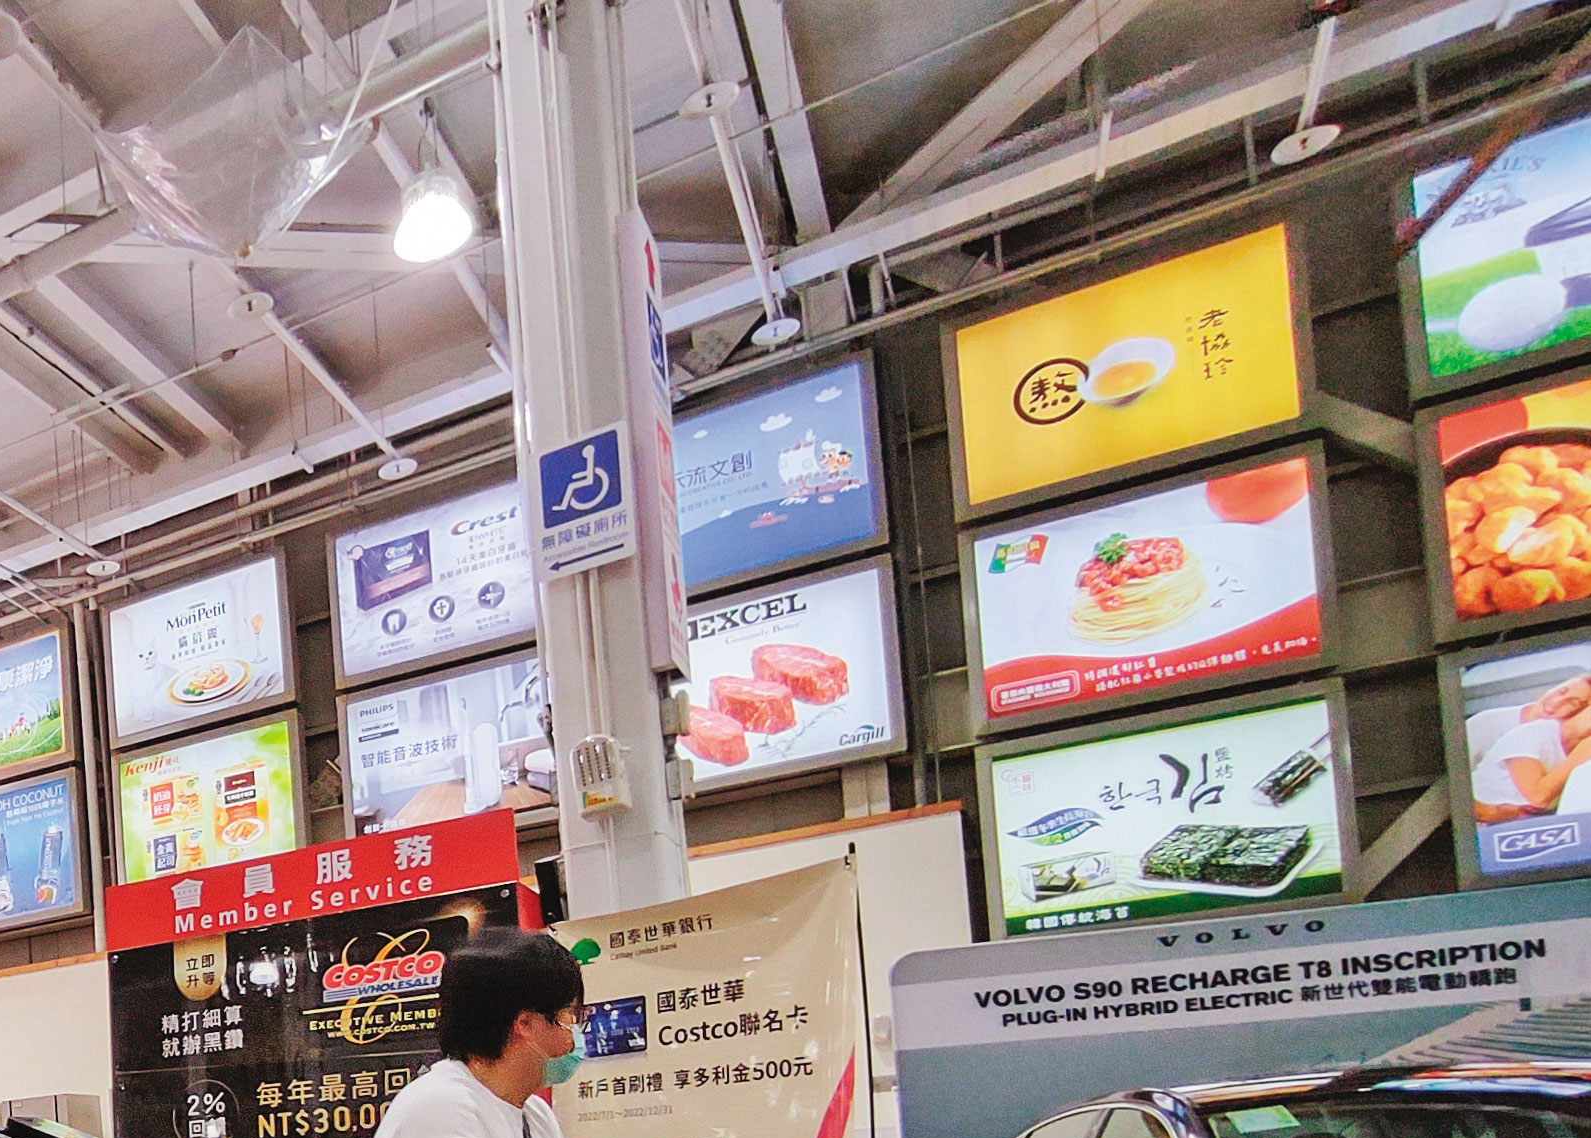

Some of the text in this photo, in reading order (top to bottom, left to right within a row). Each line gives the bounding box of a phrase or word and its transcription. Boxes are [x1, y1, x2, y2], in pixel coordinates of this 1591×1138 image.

[451, 506, 517, 536] Crest
[542, 509, 628, 552] 無障礙廁所
[589, 531, 629, 551] Restroom
[687, 593, 807, 642] EXCEL
[359, 703, 394, 718] PHILIPS
[360, 734, 459, 769] 智能音波技術
[839, 725, 886, 748] Cargill
[12, 784, 64, 808] COCONUT
[1099, 752, 1226, 814] 한국 김
[170, 835, 433, 911] 會員服務
[174, 874, 433, 934] Member Service
[610, 913, 712, 948] 國泰世華銀行
[1156, 918, 1328, 948] VOLVO
[185, 953, 215, 971] 立即
[323, 951, 445, 990] COSTCO
[974, 937, 1546, 1010] VOLVO S90 RECHARGE T8 INSCRIPTION
[185, 971, 215, 989] 升等
[358, 975, 439, 995] WHOLESALE
[656, 978, 745, 1015] 國泰世華
[1300, 967, 1518, 1004] 新世代雙能電動轎跑
[160, 1005, 243, 1036] 精打細算
[390, 1008, 441, 1022] MEMB
[658, 1004, 809, 1047] Costco聯名卡
[1001, 989, 1293, 1028] PLUG-IN HYBRID ELECTRIC
[161, 1034, 244, 1059] 就辦黑鑽
[256, 1069, 410, 1108] 每年最高回
[578, 1056, 814, 1100] 新戶首刷禮 享多利金500元
[186, 1091, 226, 1117] 2%
